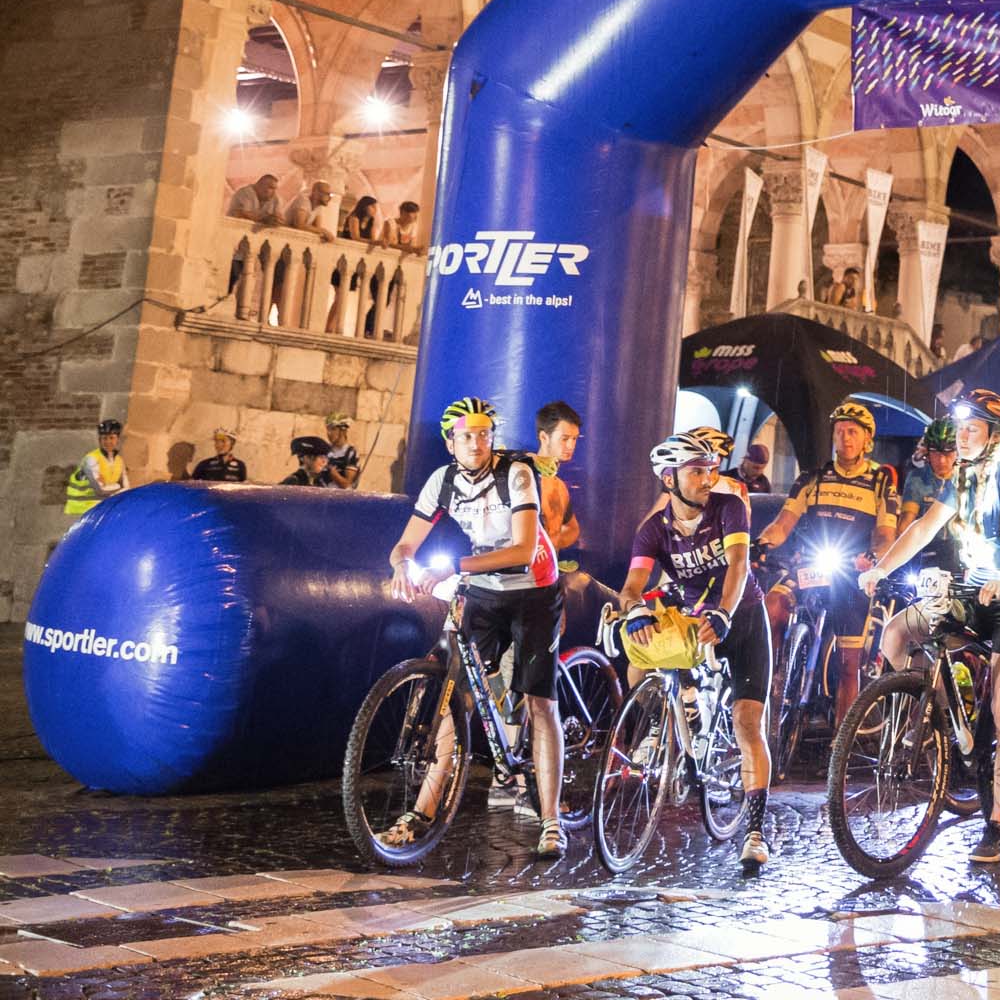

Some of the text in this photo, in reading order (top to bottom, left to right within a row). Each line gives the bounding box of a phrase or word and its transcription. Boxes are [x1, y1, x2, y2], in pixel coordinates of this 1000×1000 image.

[513, 293, 523, 305] in
[525, 293, 543, 305] the
[545, 294, 572, 309] alps!
[671, 538, 724, 569] BIKE
